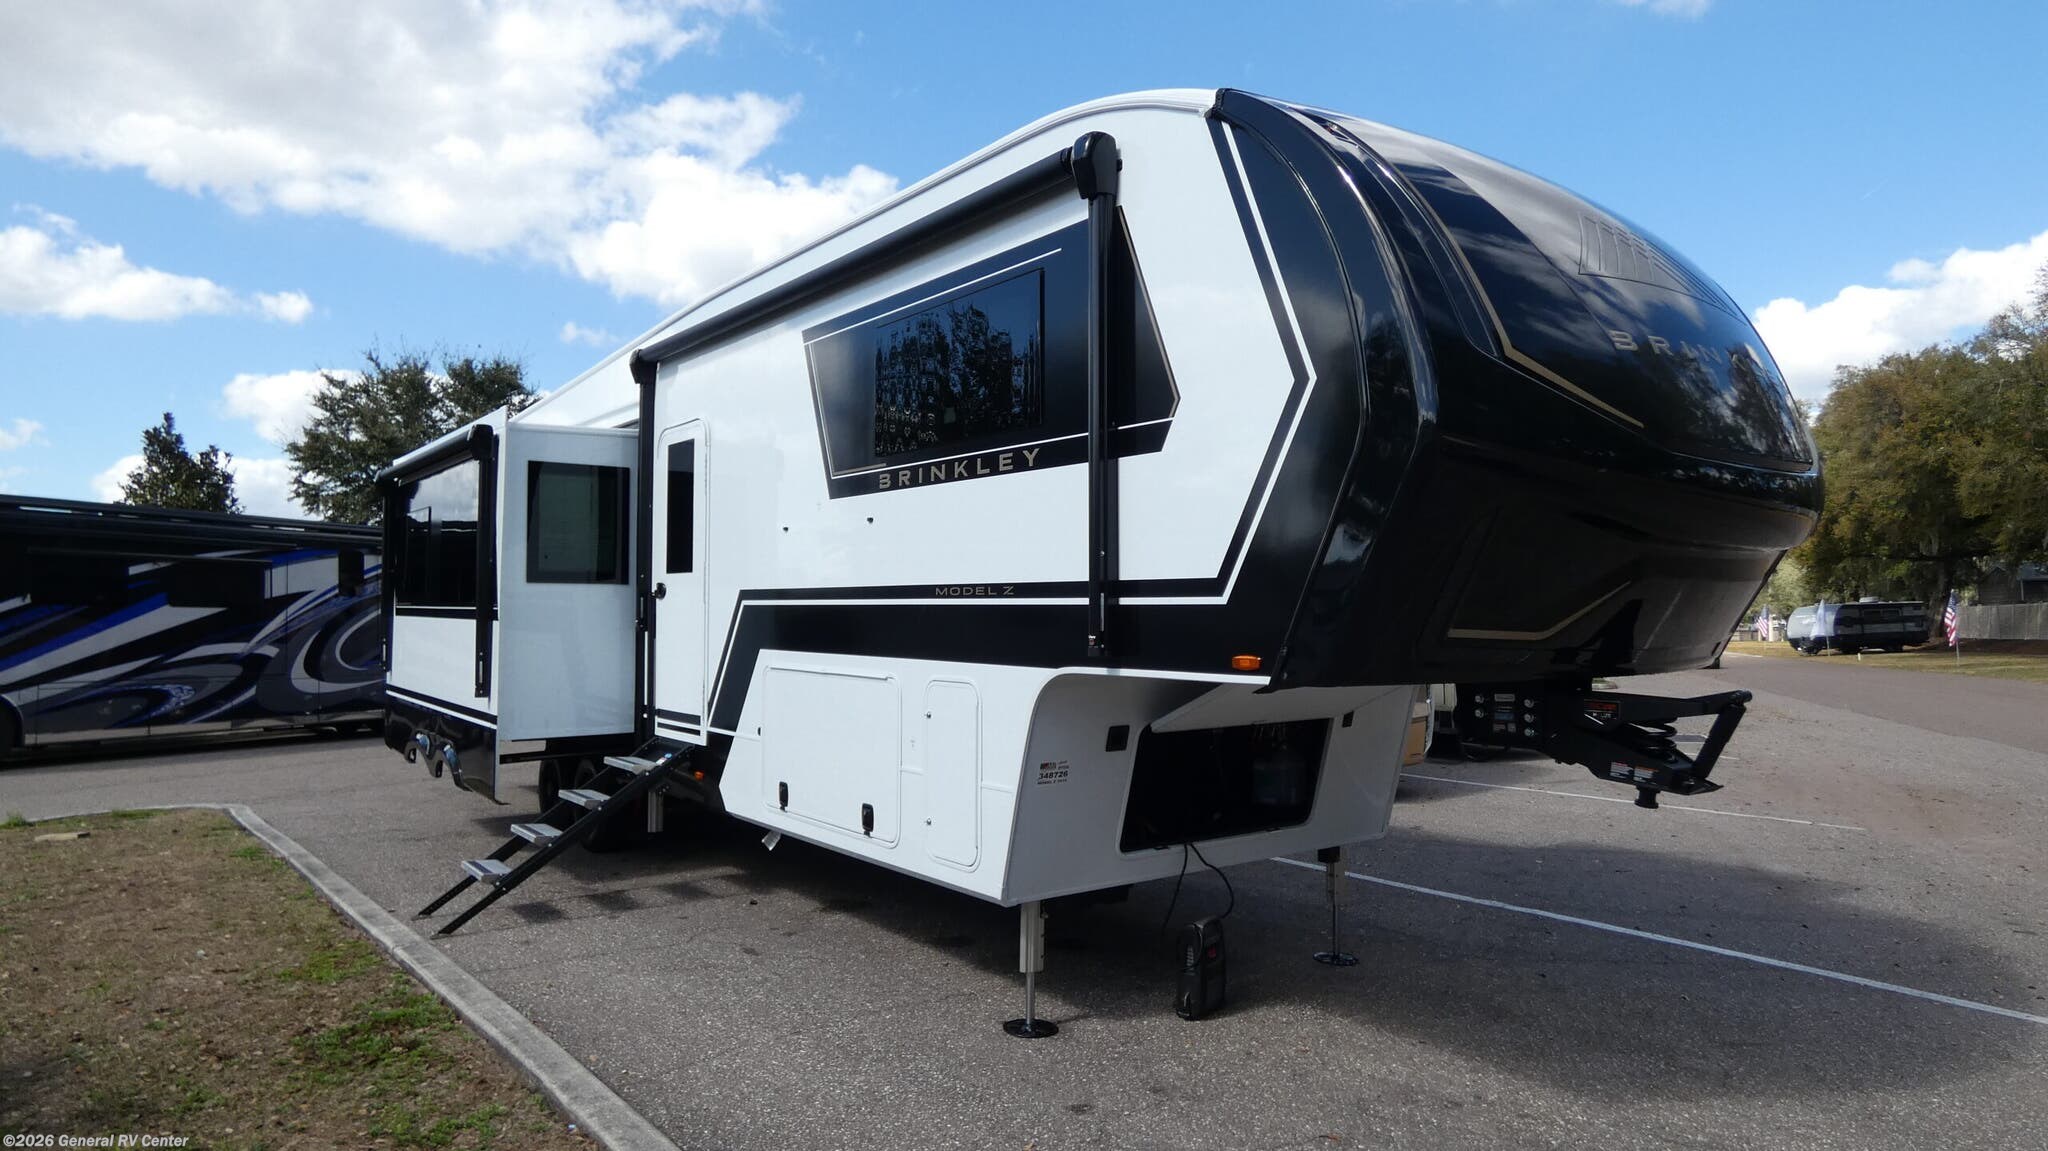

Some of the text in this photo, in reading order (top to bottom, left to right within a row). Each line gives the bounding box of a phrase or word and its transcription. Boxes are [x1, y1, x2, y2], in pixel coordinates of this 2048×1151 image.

[879, 448, 1040, 490] BRINKLEY
[935, 585, 1014, 596] MODEL Z
